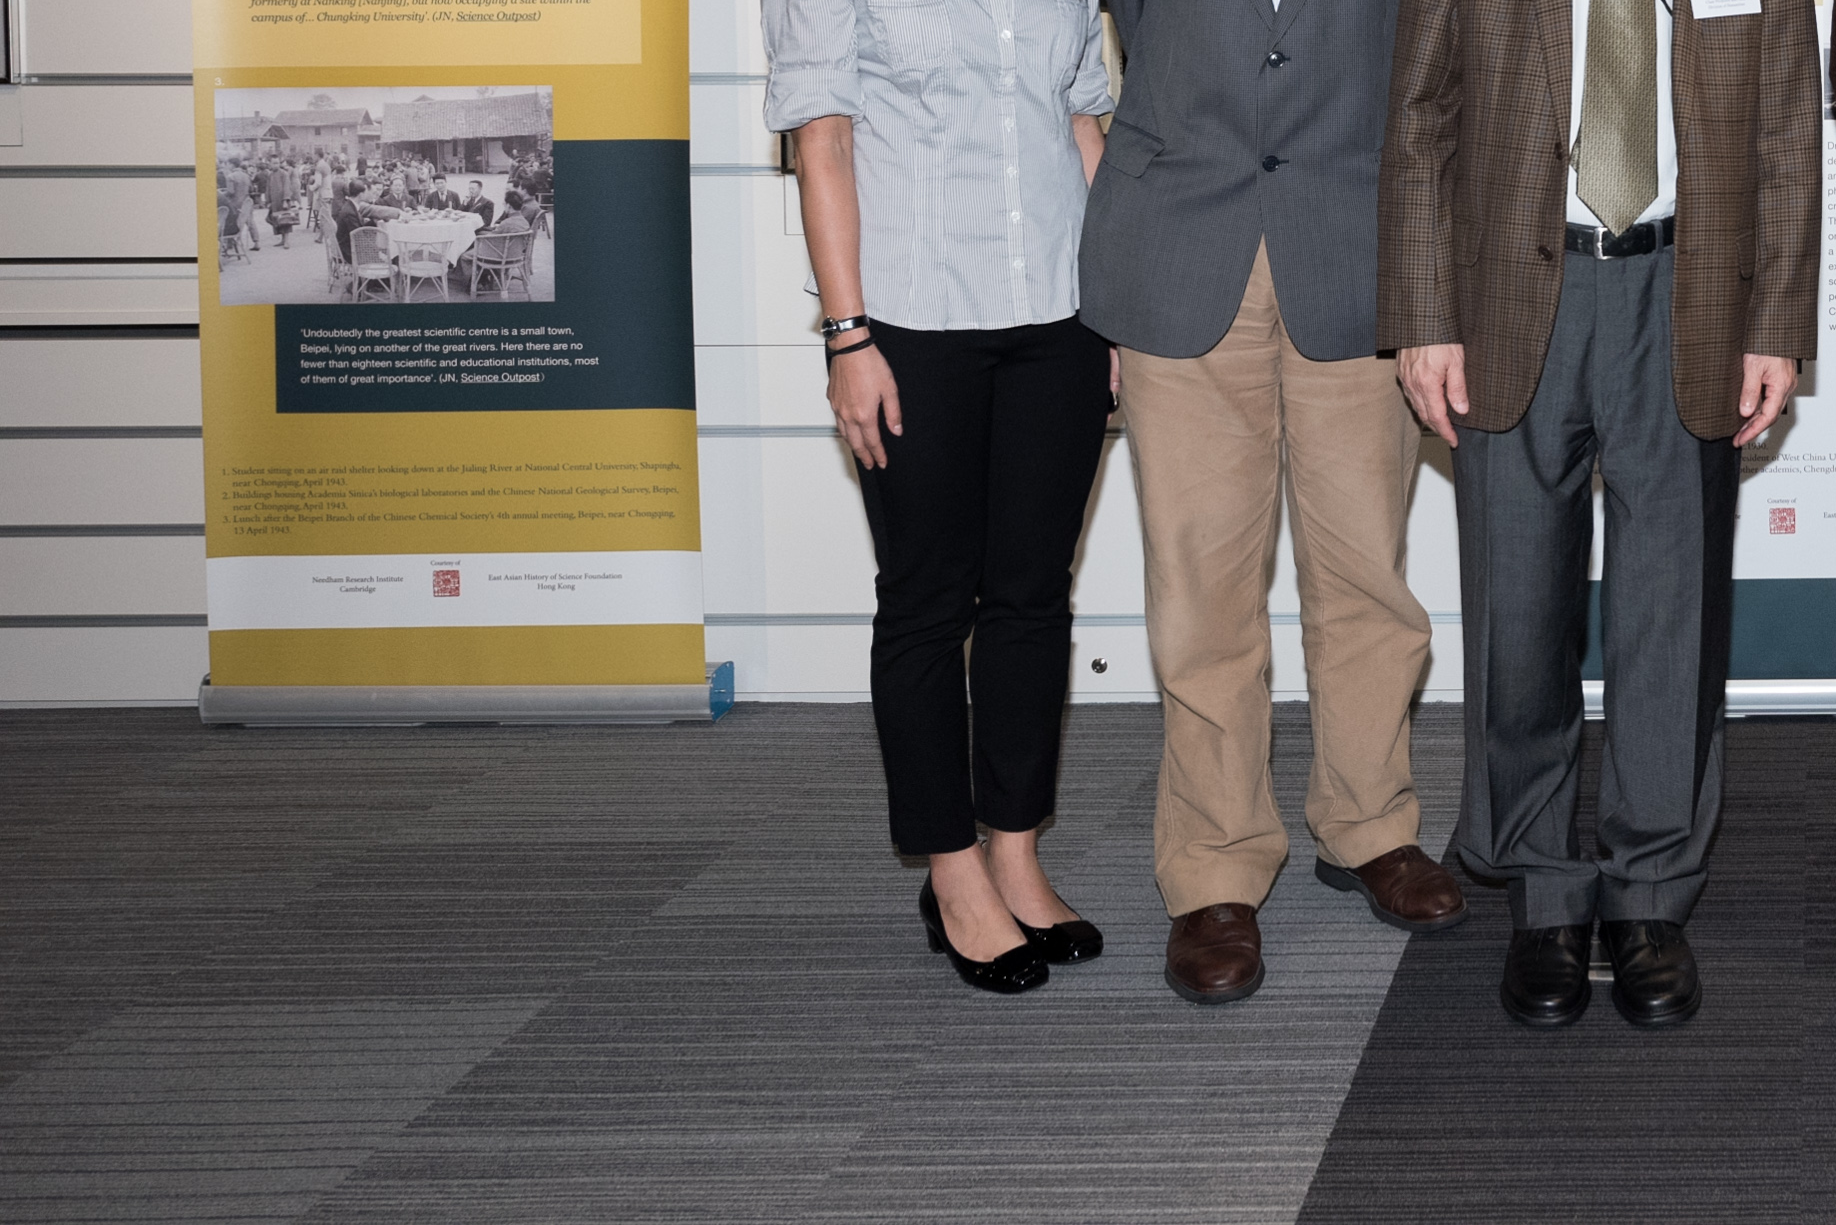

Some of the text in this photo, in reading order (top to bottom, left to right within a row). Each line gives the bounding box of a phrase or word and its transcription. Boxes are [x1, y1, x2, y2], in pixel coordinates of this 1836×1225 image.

[251, 10, 540, 24] campus of... Chungking University'. (JN, Science Outpost)
[301, 328, 362, 338] 'Undoubtedly
[365, 328, 380, 336] the
[382, 329, 420, 338] greatest
[424, 327, 465, 336] scientific
[501, 327, 508, 335] is
[520, 326, 544, 335] small
[300, 375, 309, 383] of
[338, 374, 347, 382] of
[350, 375, 374, 384] great
[377, 374, 435, 383] importance'.
[439, 373, 457, 383] (JN,
[461, 372, 499, 382] Science
[502, 372, 546, 383] Outpost)
[1782, 454, 1800, 462] West
[1761, 466, 1802, 474] academics,
[524, 574, 548, 583] History
[558, 573, 582, 583] Science
[339, 585, 375, 593] Cambridge
